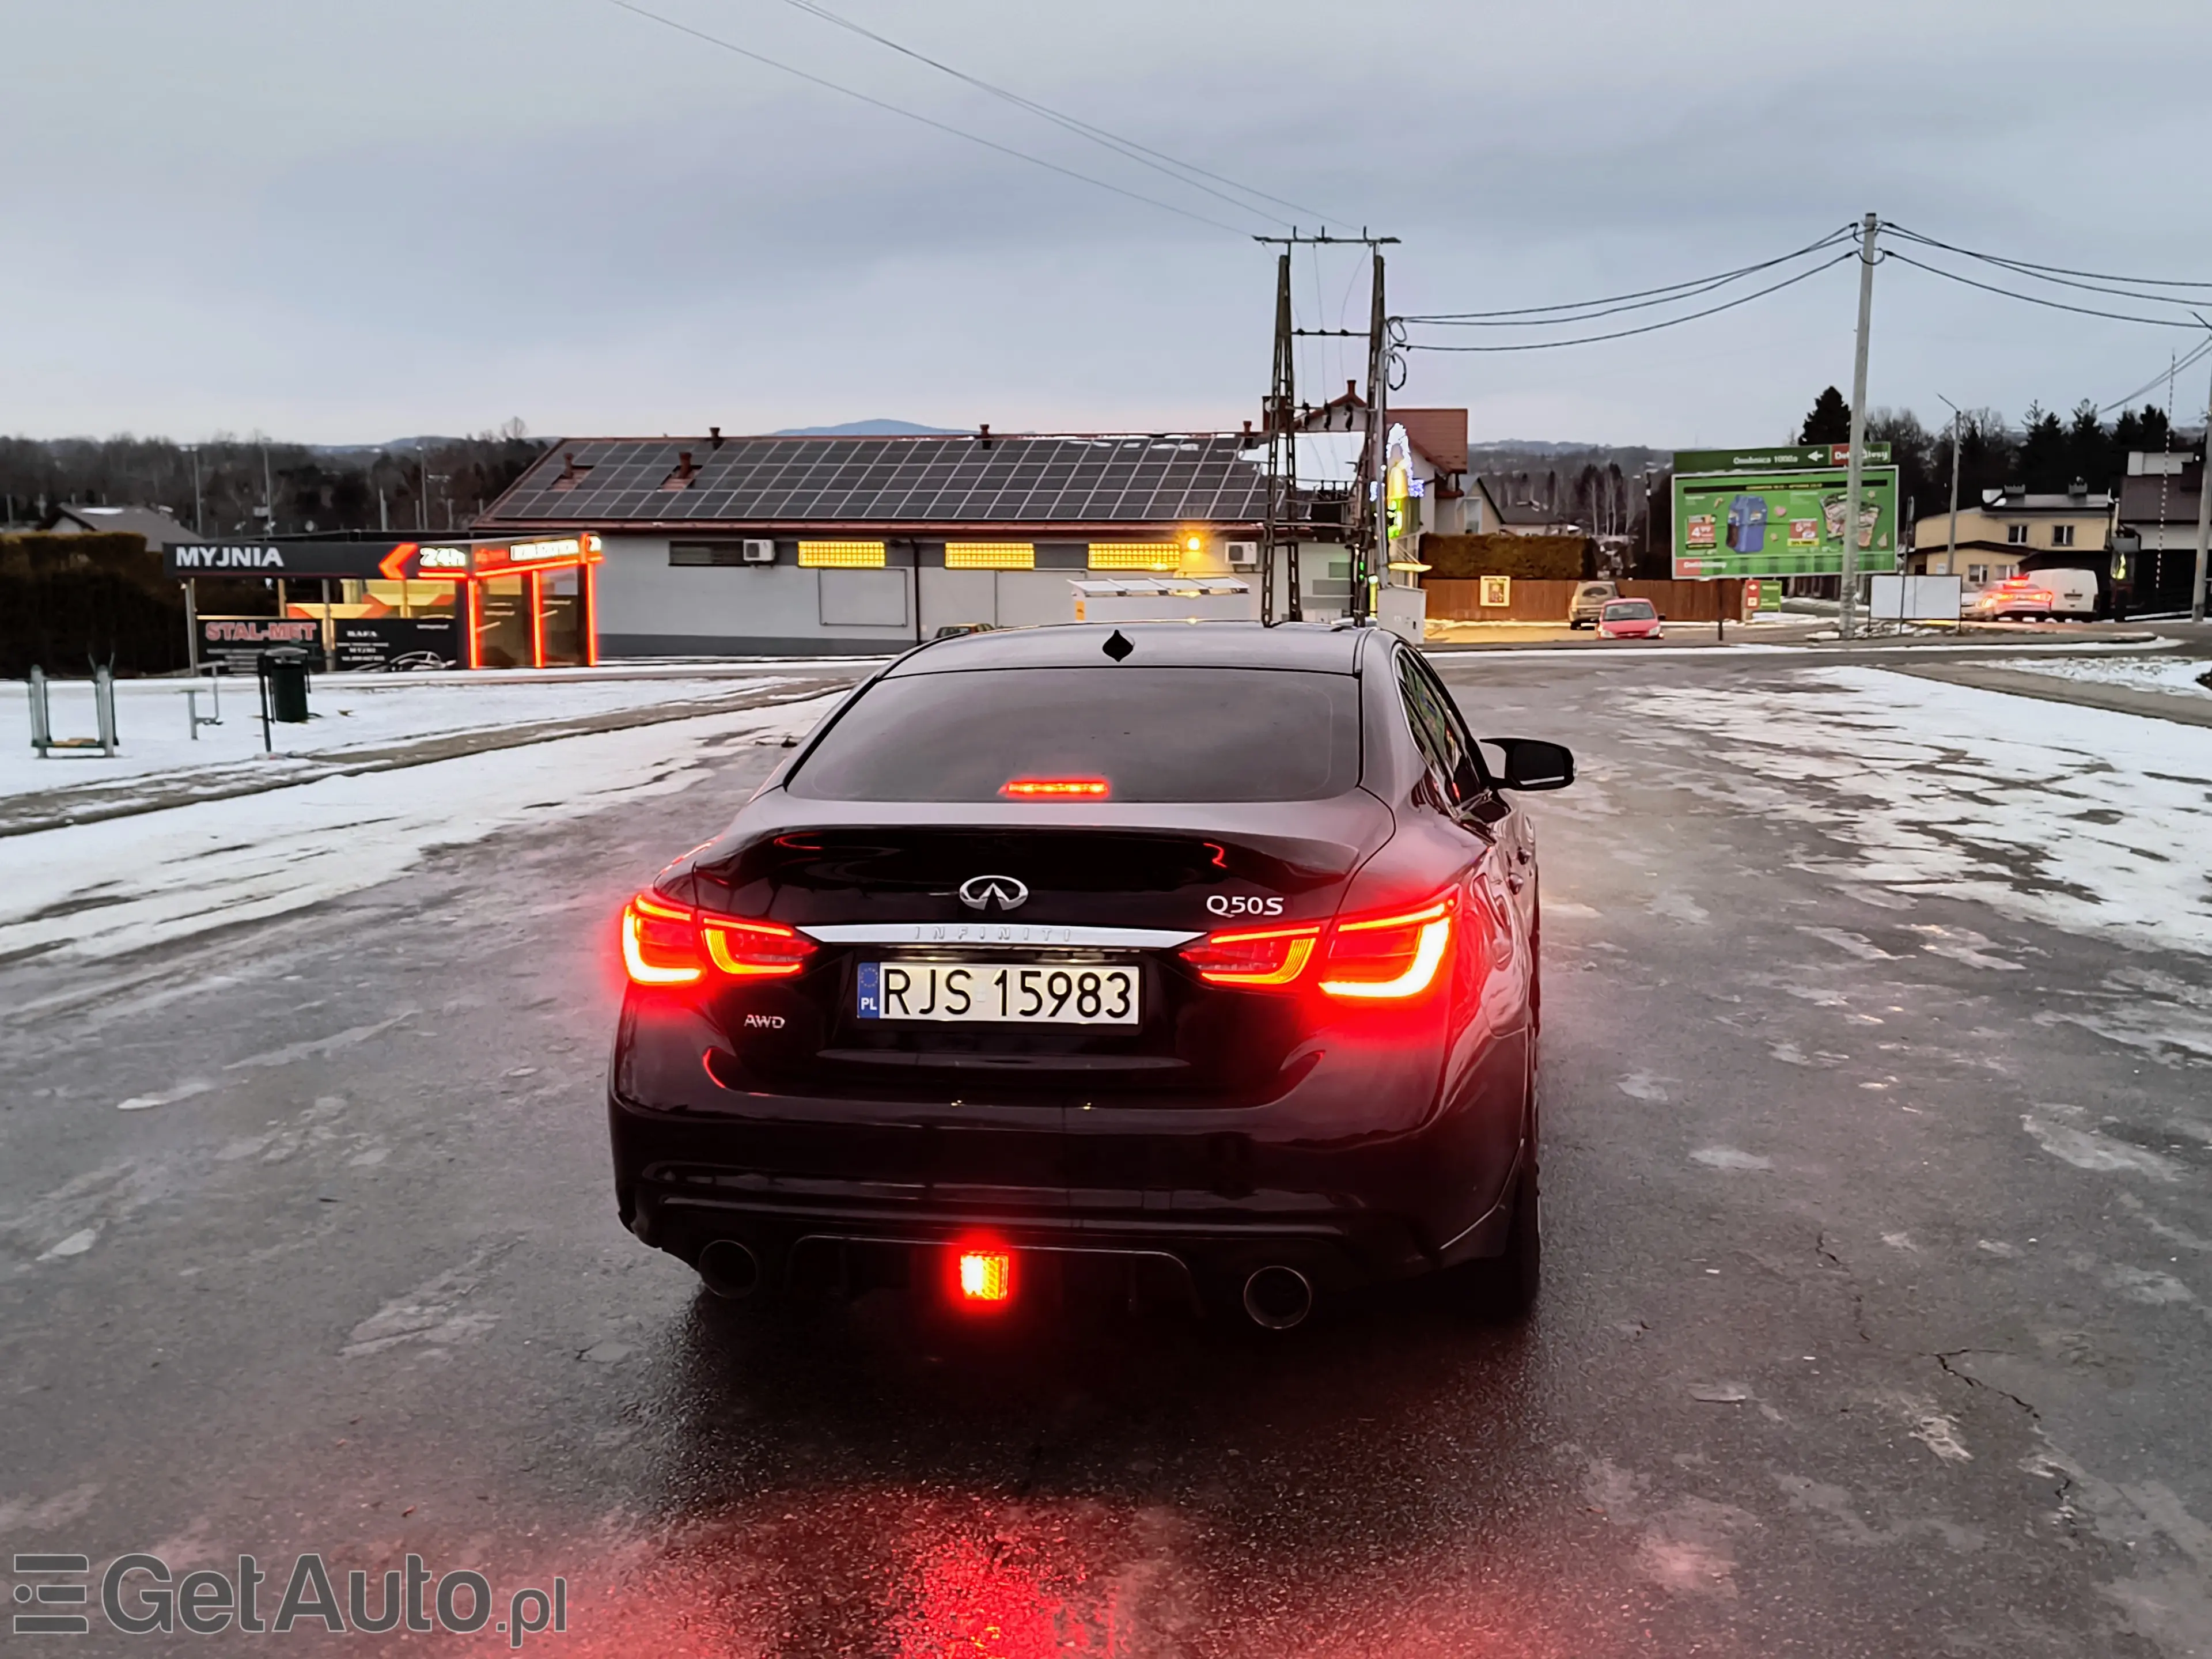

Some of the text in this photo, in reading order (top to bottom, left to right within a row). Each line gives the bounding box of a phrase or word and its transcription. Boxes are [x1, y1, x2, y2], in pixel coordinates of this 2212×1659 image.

[176, 546, 285, 567] MYJNIA
[420, 547, 466, 567] 24h
[205, 622, 317, 641] STAL-MET
[1206, 895, 1285, 918] Q50S
[914, 926, 1071, 942] INFINITI
[884, 967, 1131, 1019] RJS 15983
[861, 997, 877, 1011] PL
[744, 1014, 786, 1029] AWD
